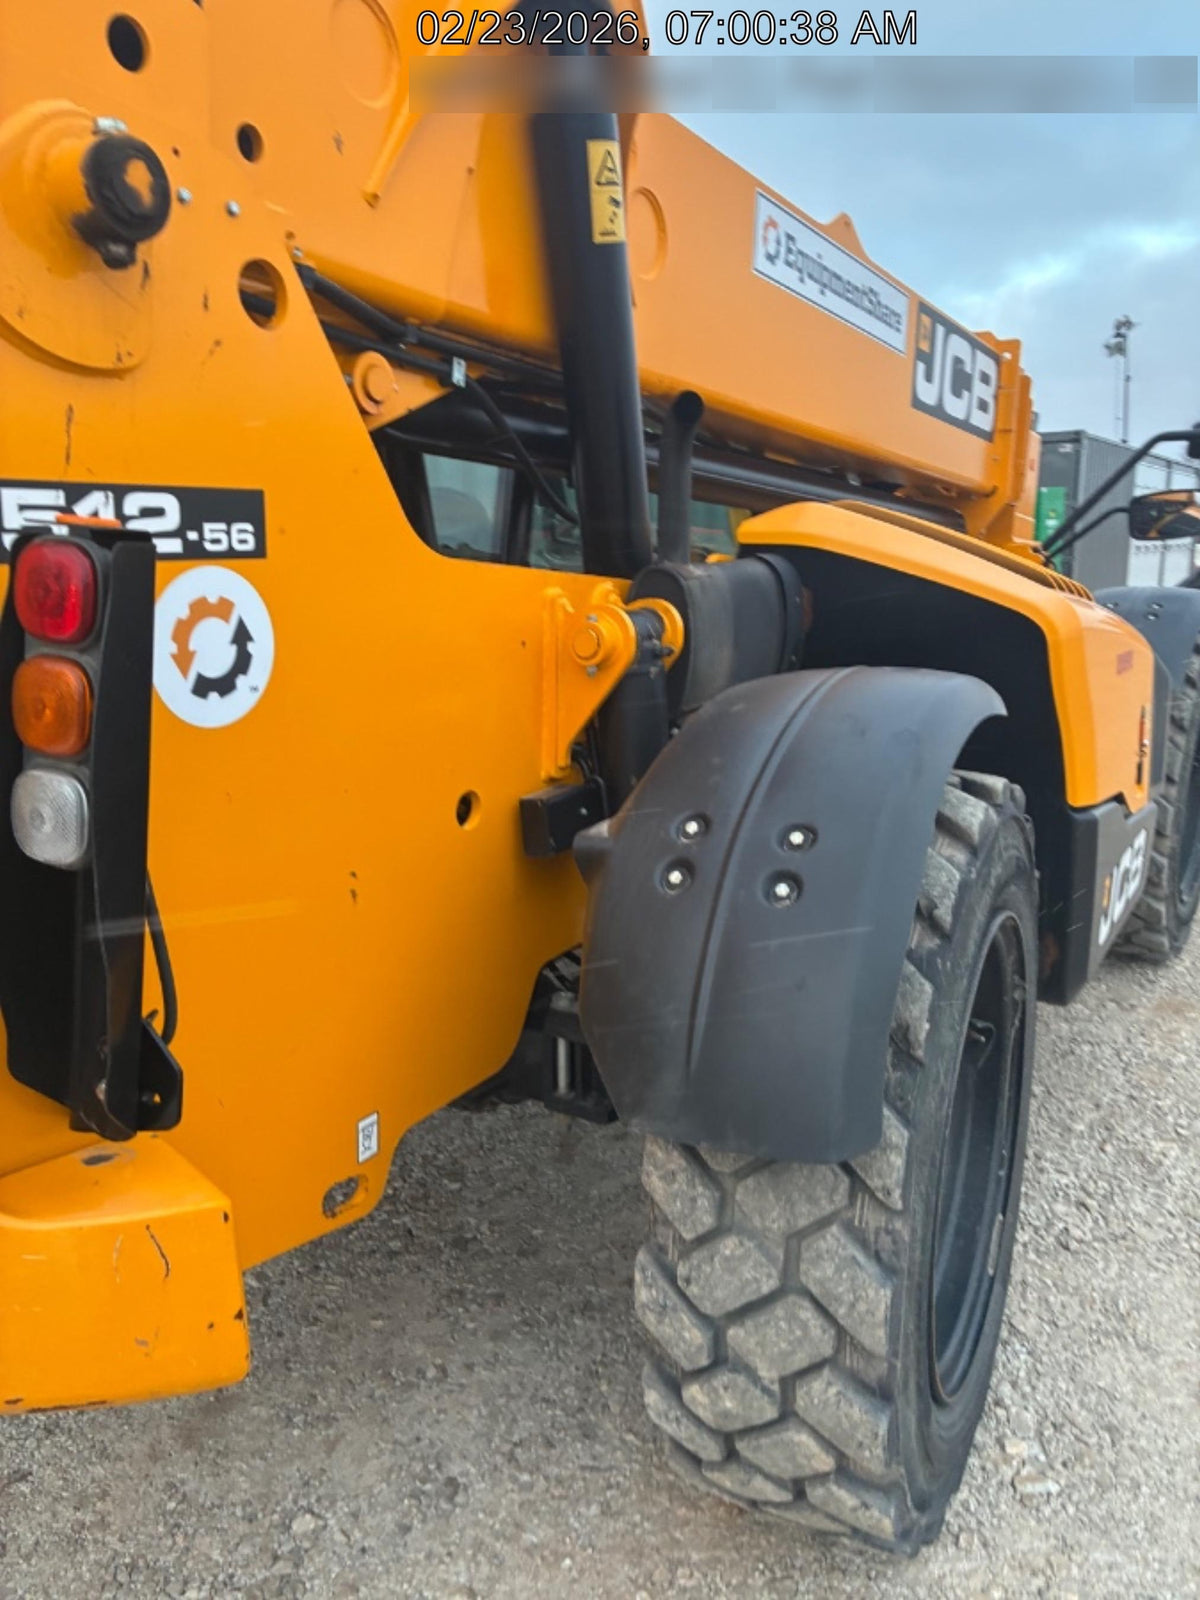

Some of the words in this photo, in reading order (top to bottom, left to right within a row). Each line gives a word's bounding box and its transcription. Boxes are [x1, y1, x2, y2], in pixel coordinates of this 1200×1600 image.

[783, 231, 903, 334] EquipmentShare
[915, 320, 998, 433] JCB
[1098, 827, 1147, 946] JCB
